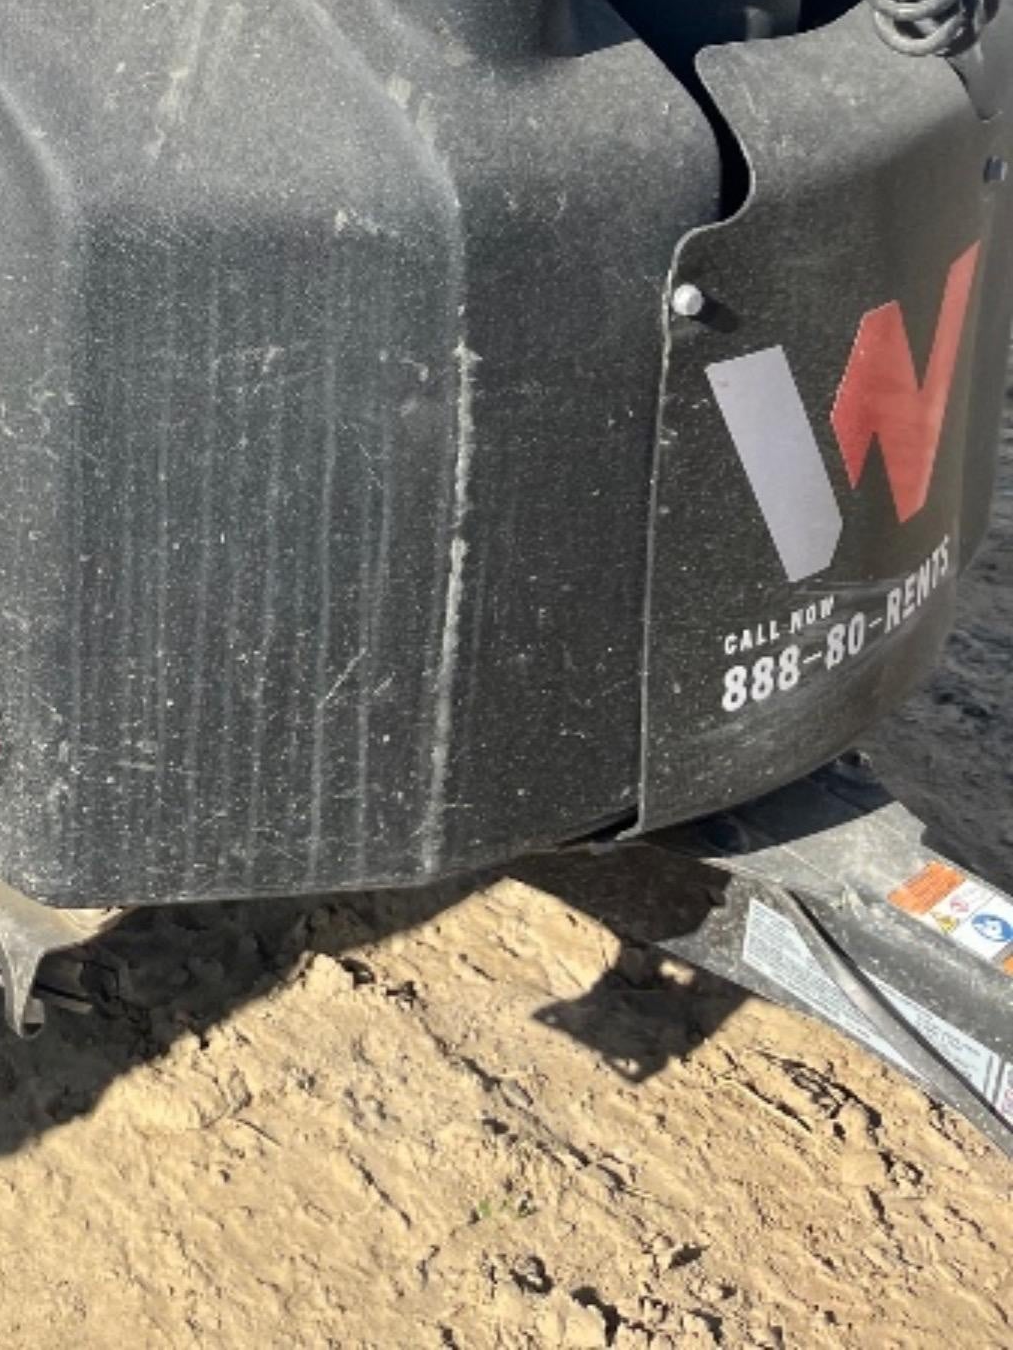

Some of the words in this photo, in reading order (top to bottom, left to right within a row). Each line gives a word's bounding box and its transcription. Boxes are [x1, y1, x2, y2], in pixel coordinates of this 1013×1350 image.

[721, 534, 950, 712] 888-80-RENTS
[724, 619, 781, 655] CALL
[790, 593, 835, 634] NOW
